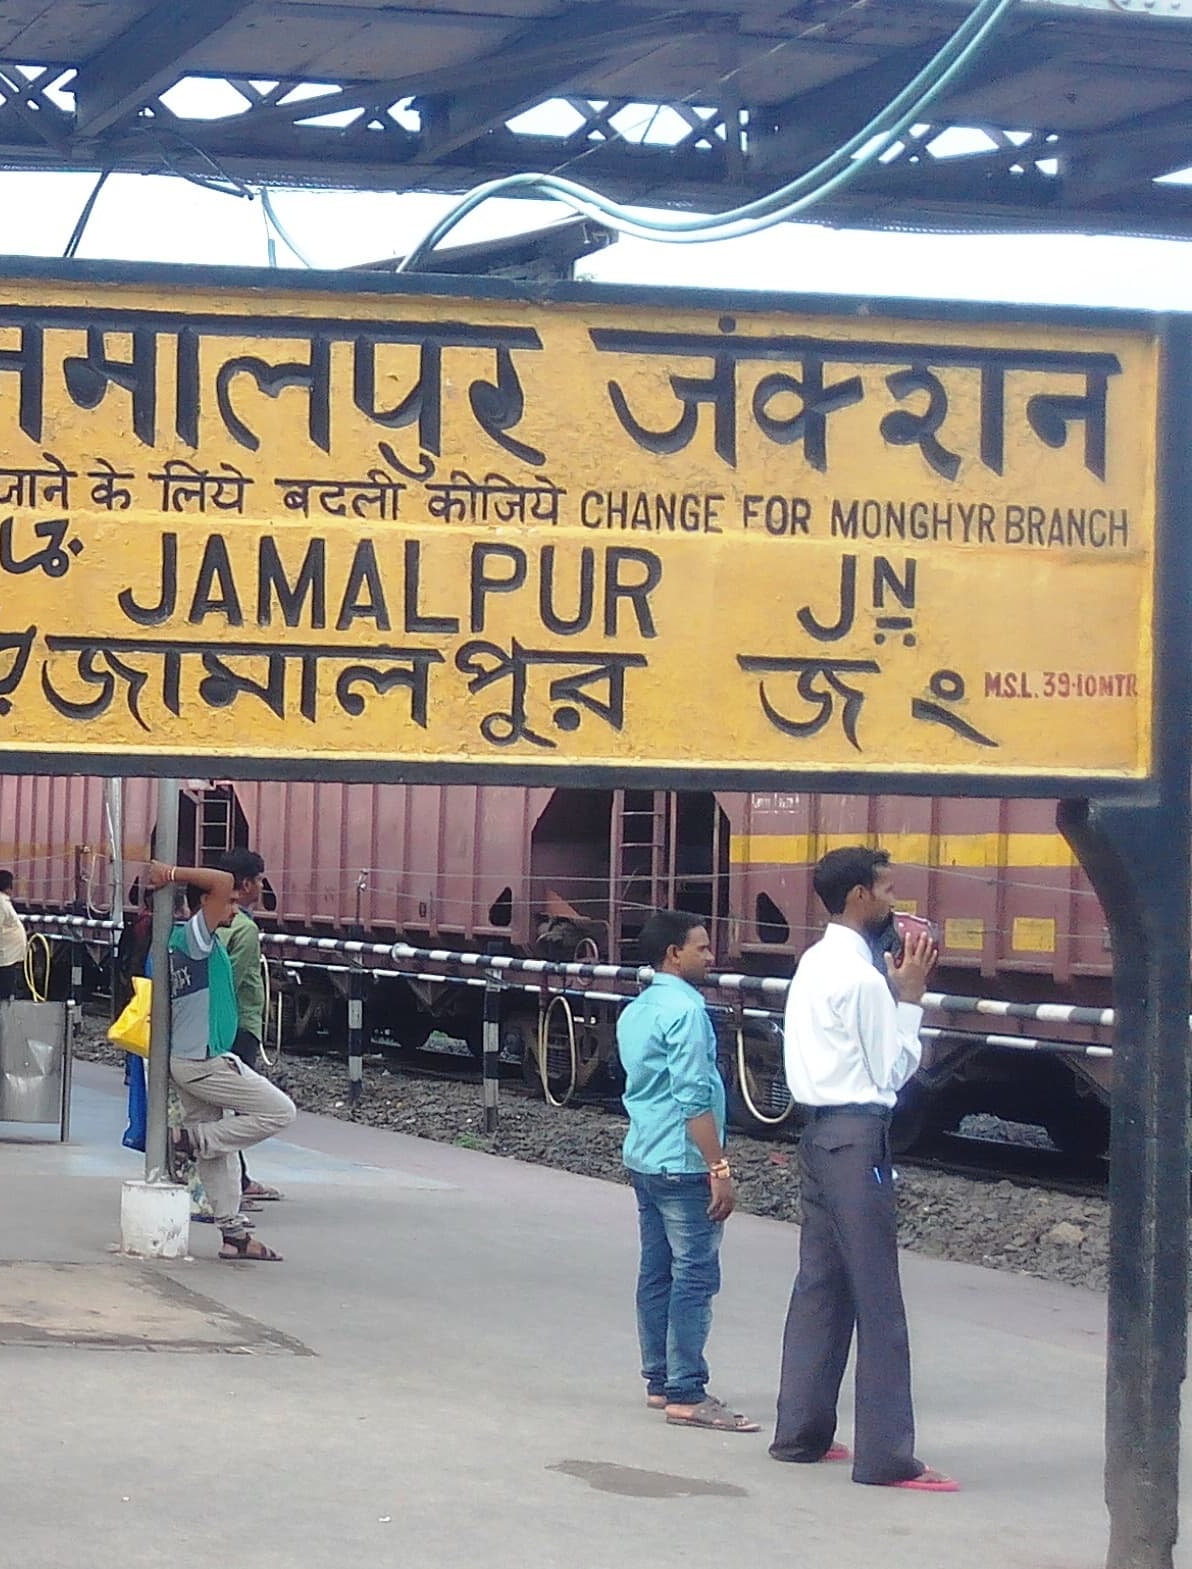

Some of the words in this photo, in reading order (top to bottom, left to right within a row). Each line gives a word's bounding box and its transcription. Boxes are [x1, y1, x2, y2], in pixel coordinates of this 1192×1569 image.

[588, 315, 1123, 482] जंक्शन
[87, 457, 135, 510] के
[148, 459, 254, 514] लिये
[274, 468, 406, 520] बदली
[425, 470, 567, 525] कीजिये
[580, 489, 725, 534] CHANGE
[742, 493, 812, 535] FOR
[831, 497, 997, 546] MONGHYR
[1005, 504, 1129, 549] BRANCH
[118, 531, 663, 638] JAMALPUR
[984, 671, 1039, 698] M.S.L.
